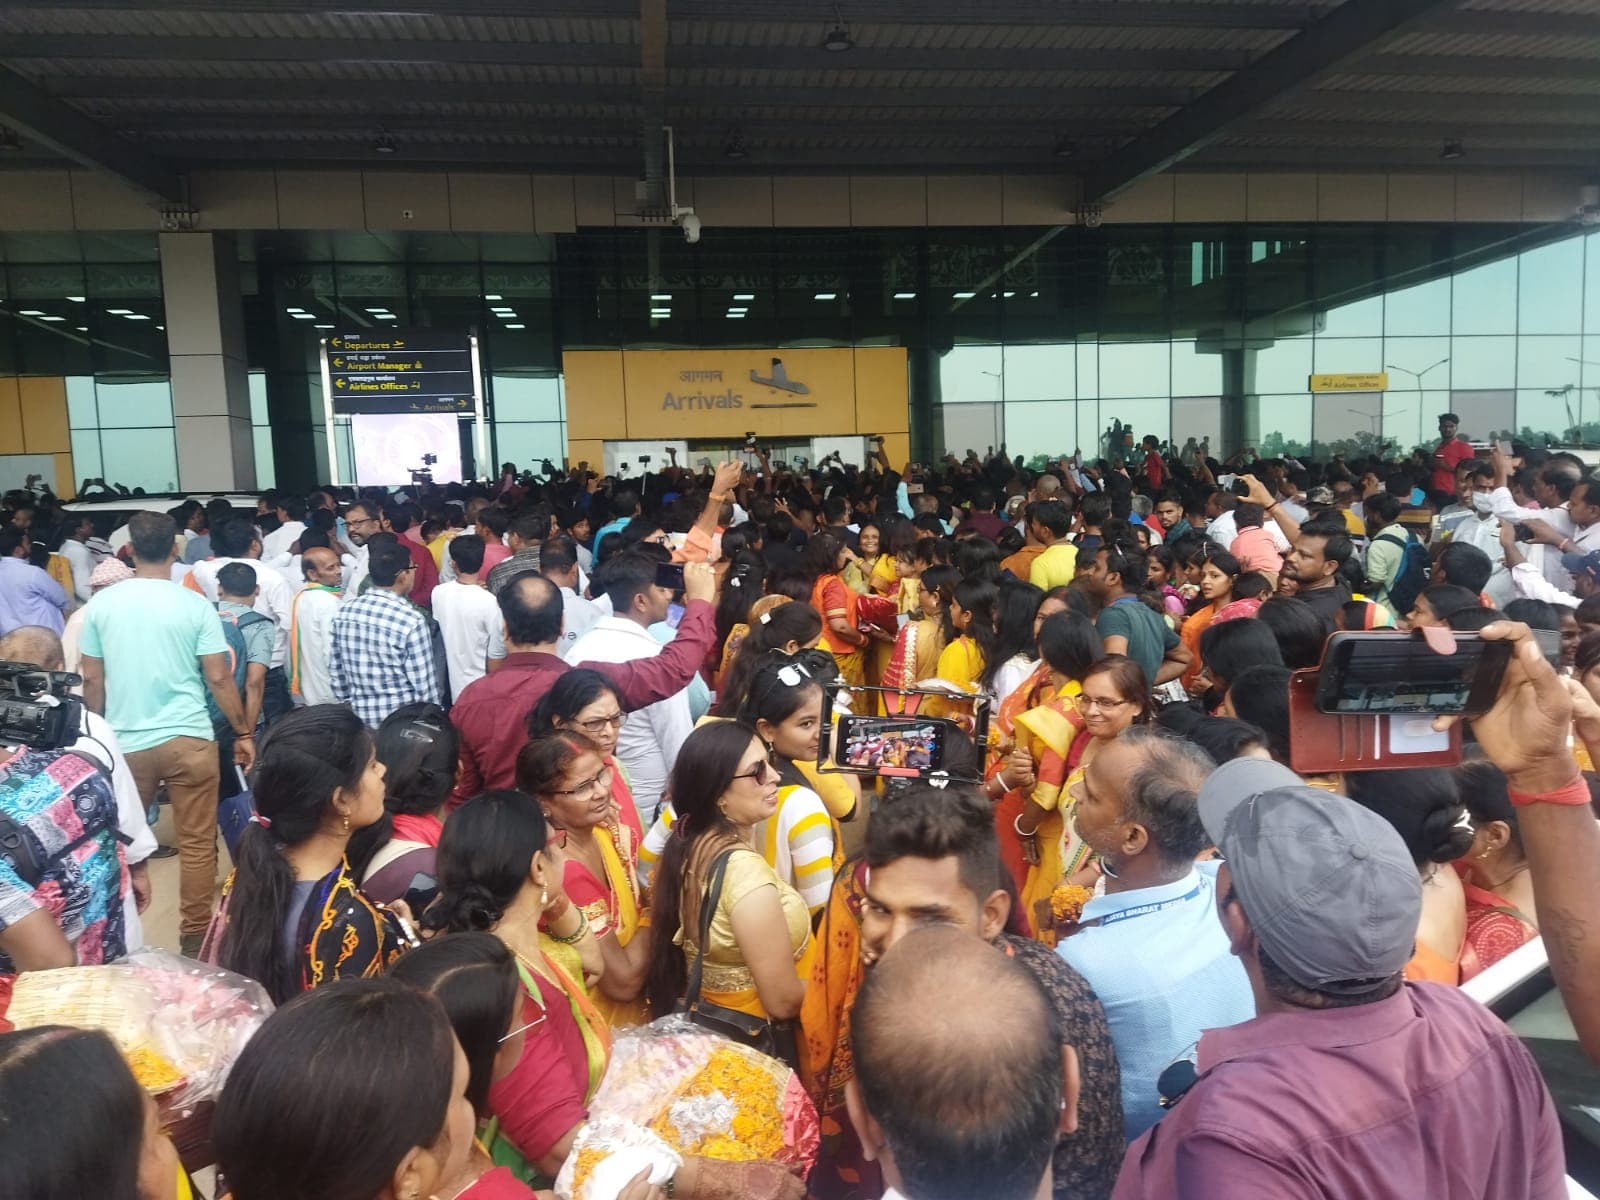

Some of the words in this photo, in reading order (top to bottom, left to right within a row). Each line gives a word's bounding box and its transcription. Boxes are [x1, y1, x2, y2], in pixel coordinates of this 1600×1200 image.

[344, 342, 390, 350] Departures
[347, 362, 376, 371] Airport
[377, 362, 412, 371] Manager
[680, 370, 723, 382] आगमन
[349, 383, 379, 391] Airlines
[662, 389, 743, 410] Arrivals
[1126, 904, 1159, 916] BHARAT
